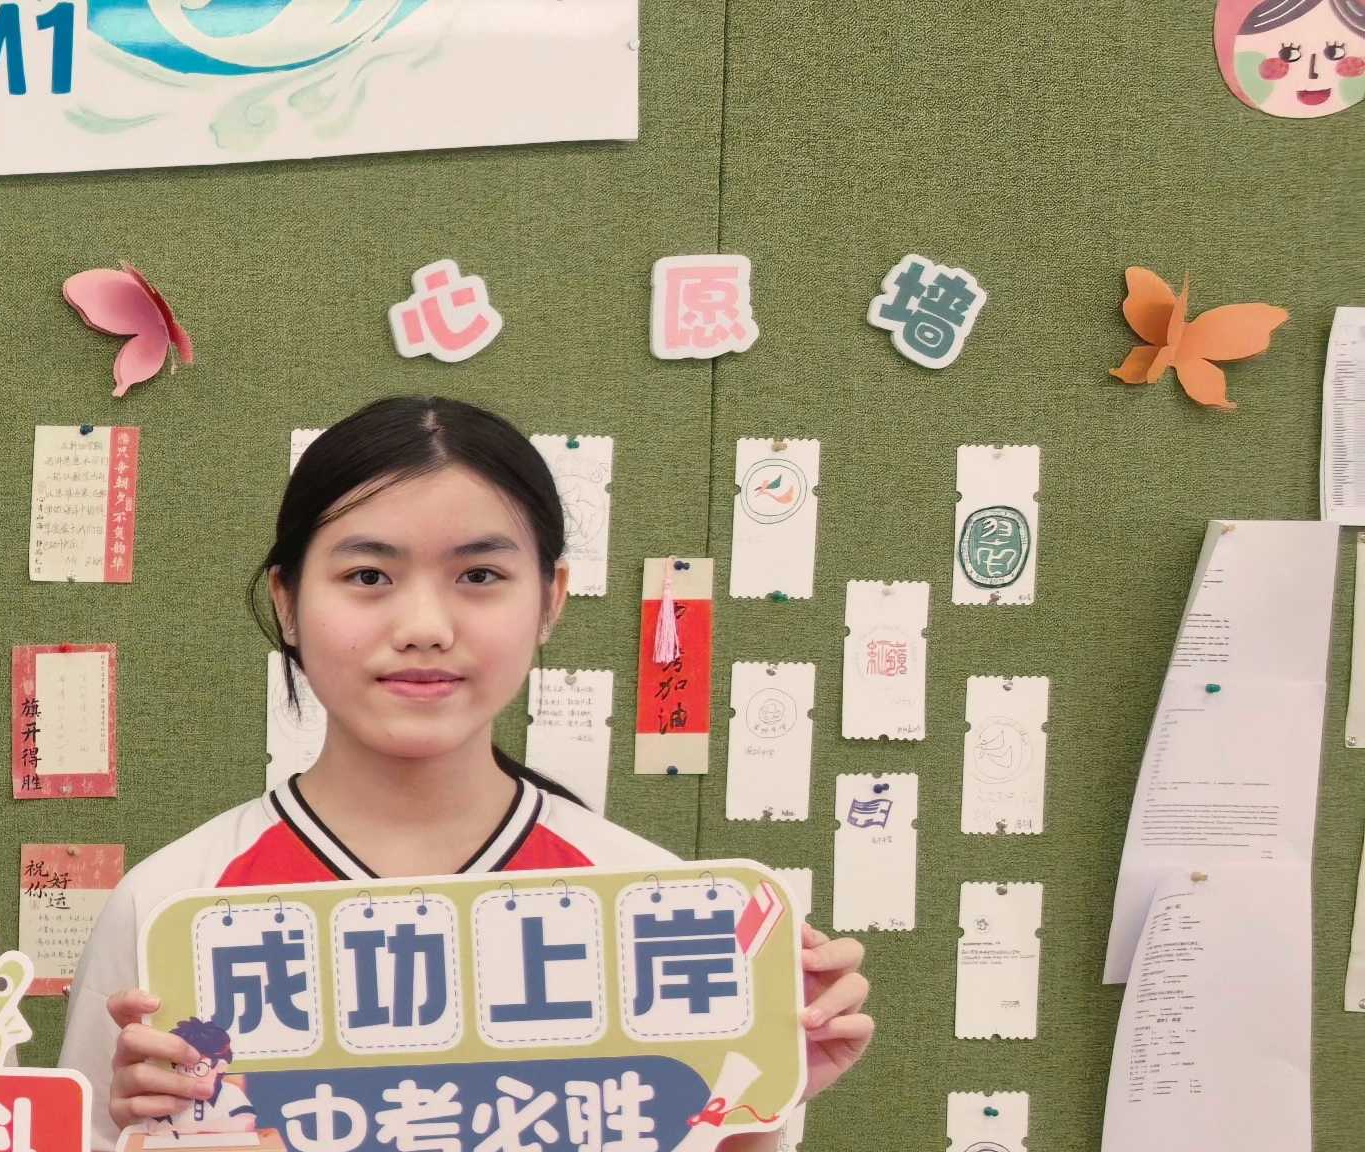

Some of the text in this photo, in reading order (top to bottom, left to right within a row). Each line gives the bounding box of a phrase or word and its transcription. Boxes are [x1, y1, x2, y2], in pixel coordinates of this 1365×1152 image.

[20, 697, 43, 791] 旗开得胜
[208, 906, 741, 1035] 成功上岸
